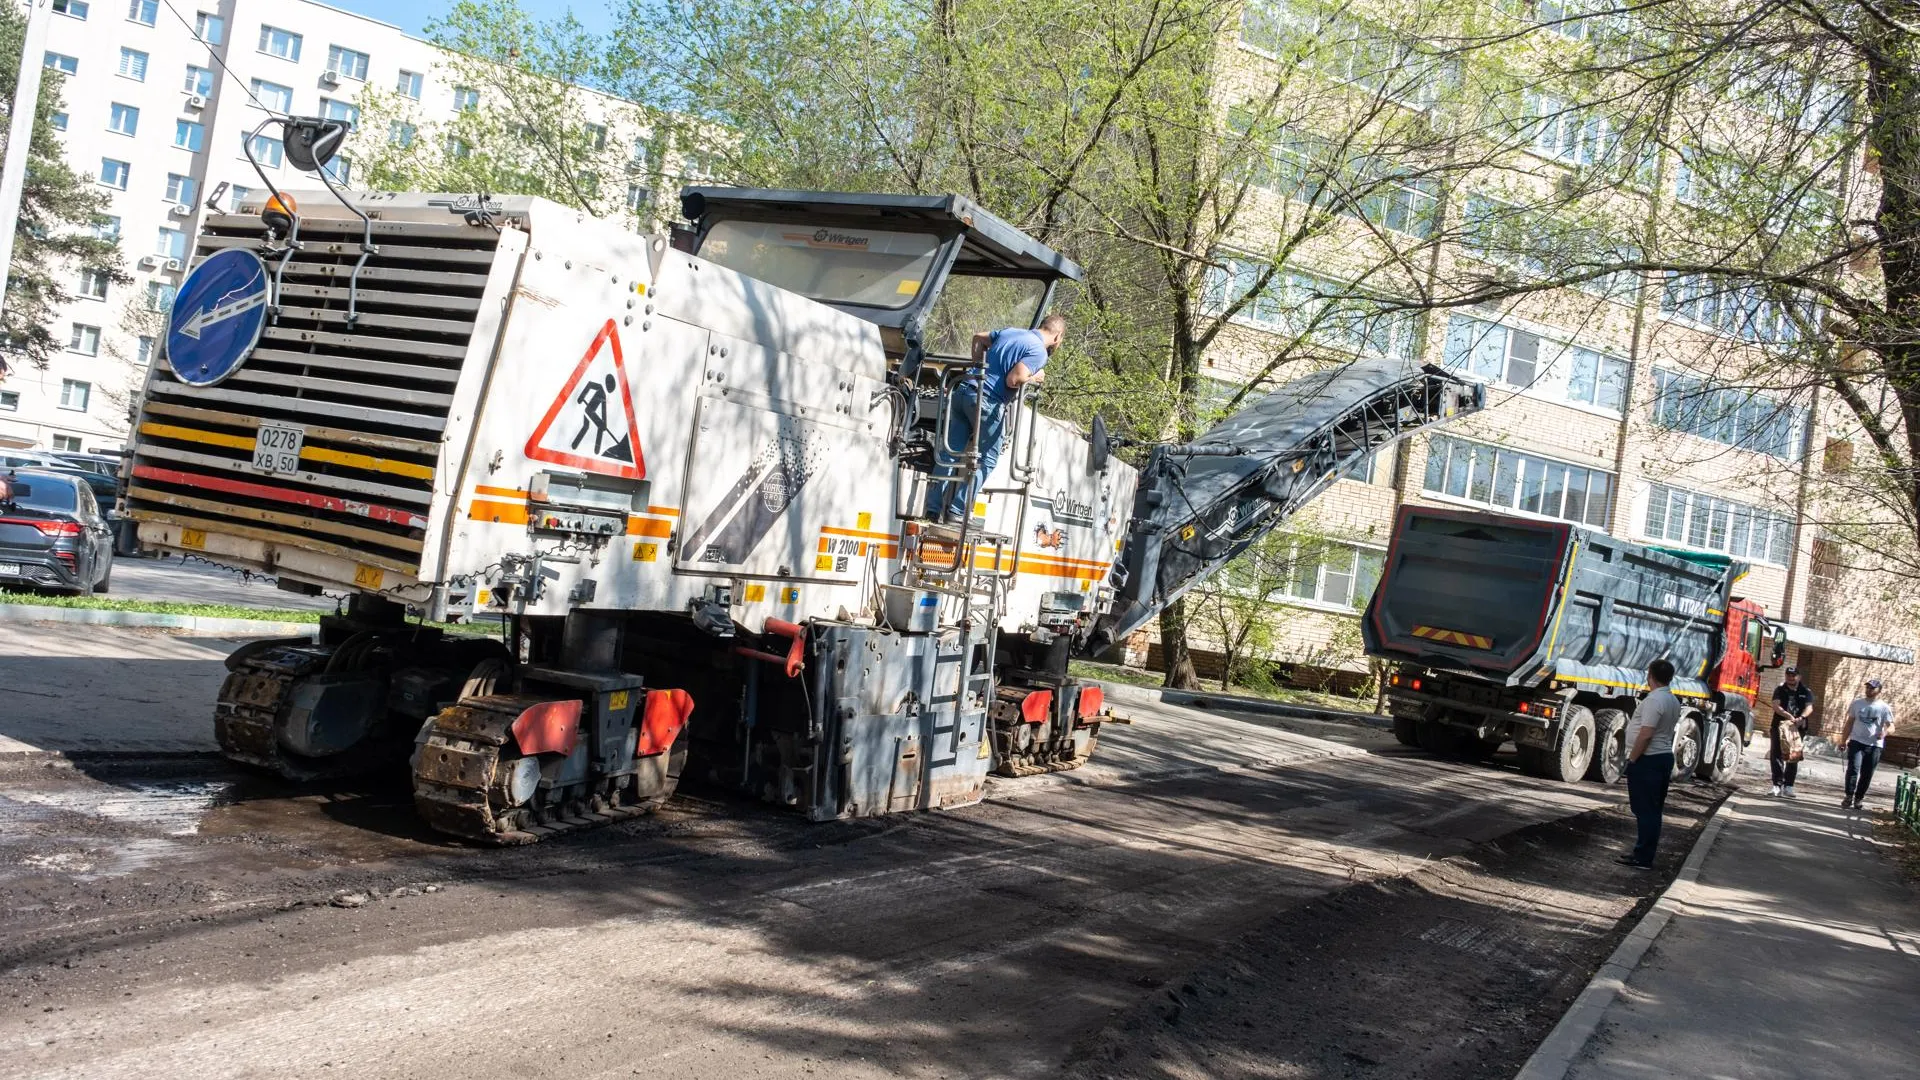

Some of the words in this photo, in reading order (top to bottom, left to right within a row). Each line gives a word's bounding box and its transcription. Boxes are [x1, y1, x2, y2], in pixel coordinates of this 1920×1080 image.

[469, 198, 502, 211] Wigen
[829, 232, 868, 246] Wirtgen
[262, 428, 297, 450] 0278
[280, 456, 295, 472] 50
[1066, 497, 1093, 519] Wirtgen
[827, 537, 838, 554] W
[837, 538, 860, 556] 2100
